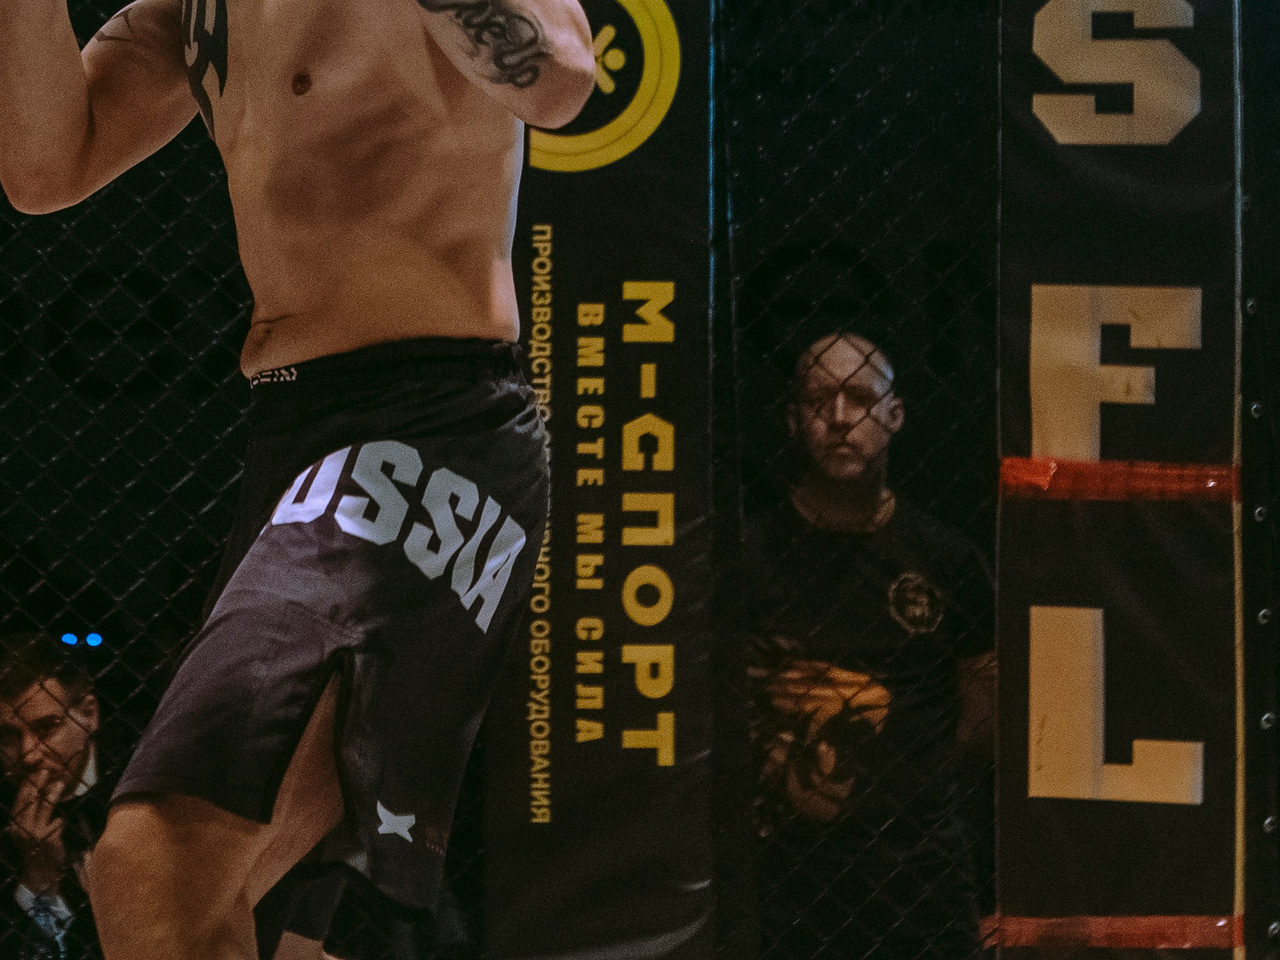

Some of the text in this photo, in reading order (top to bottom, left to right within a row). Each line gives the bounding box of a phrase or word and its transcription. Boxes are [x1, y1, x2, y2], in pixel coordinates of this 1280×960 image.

[269, 440, 526, 634] USSIA
[575, 303, 605, 743] ВМЕСТЕ МЫ СИЛА
[622, 281, 675, 767] М-СПОРТ
[526, 619, 551, 824] ОБОРУДОВАНИЯ
